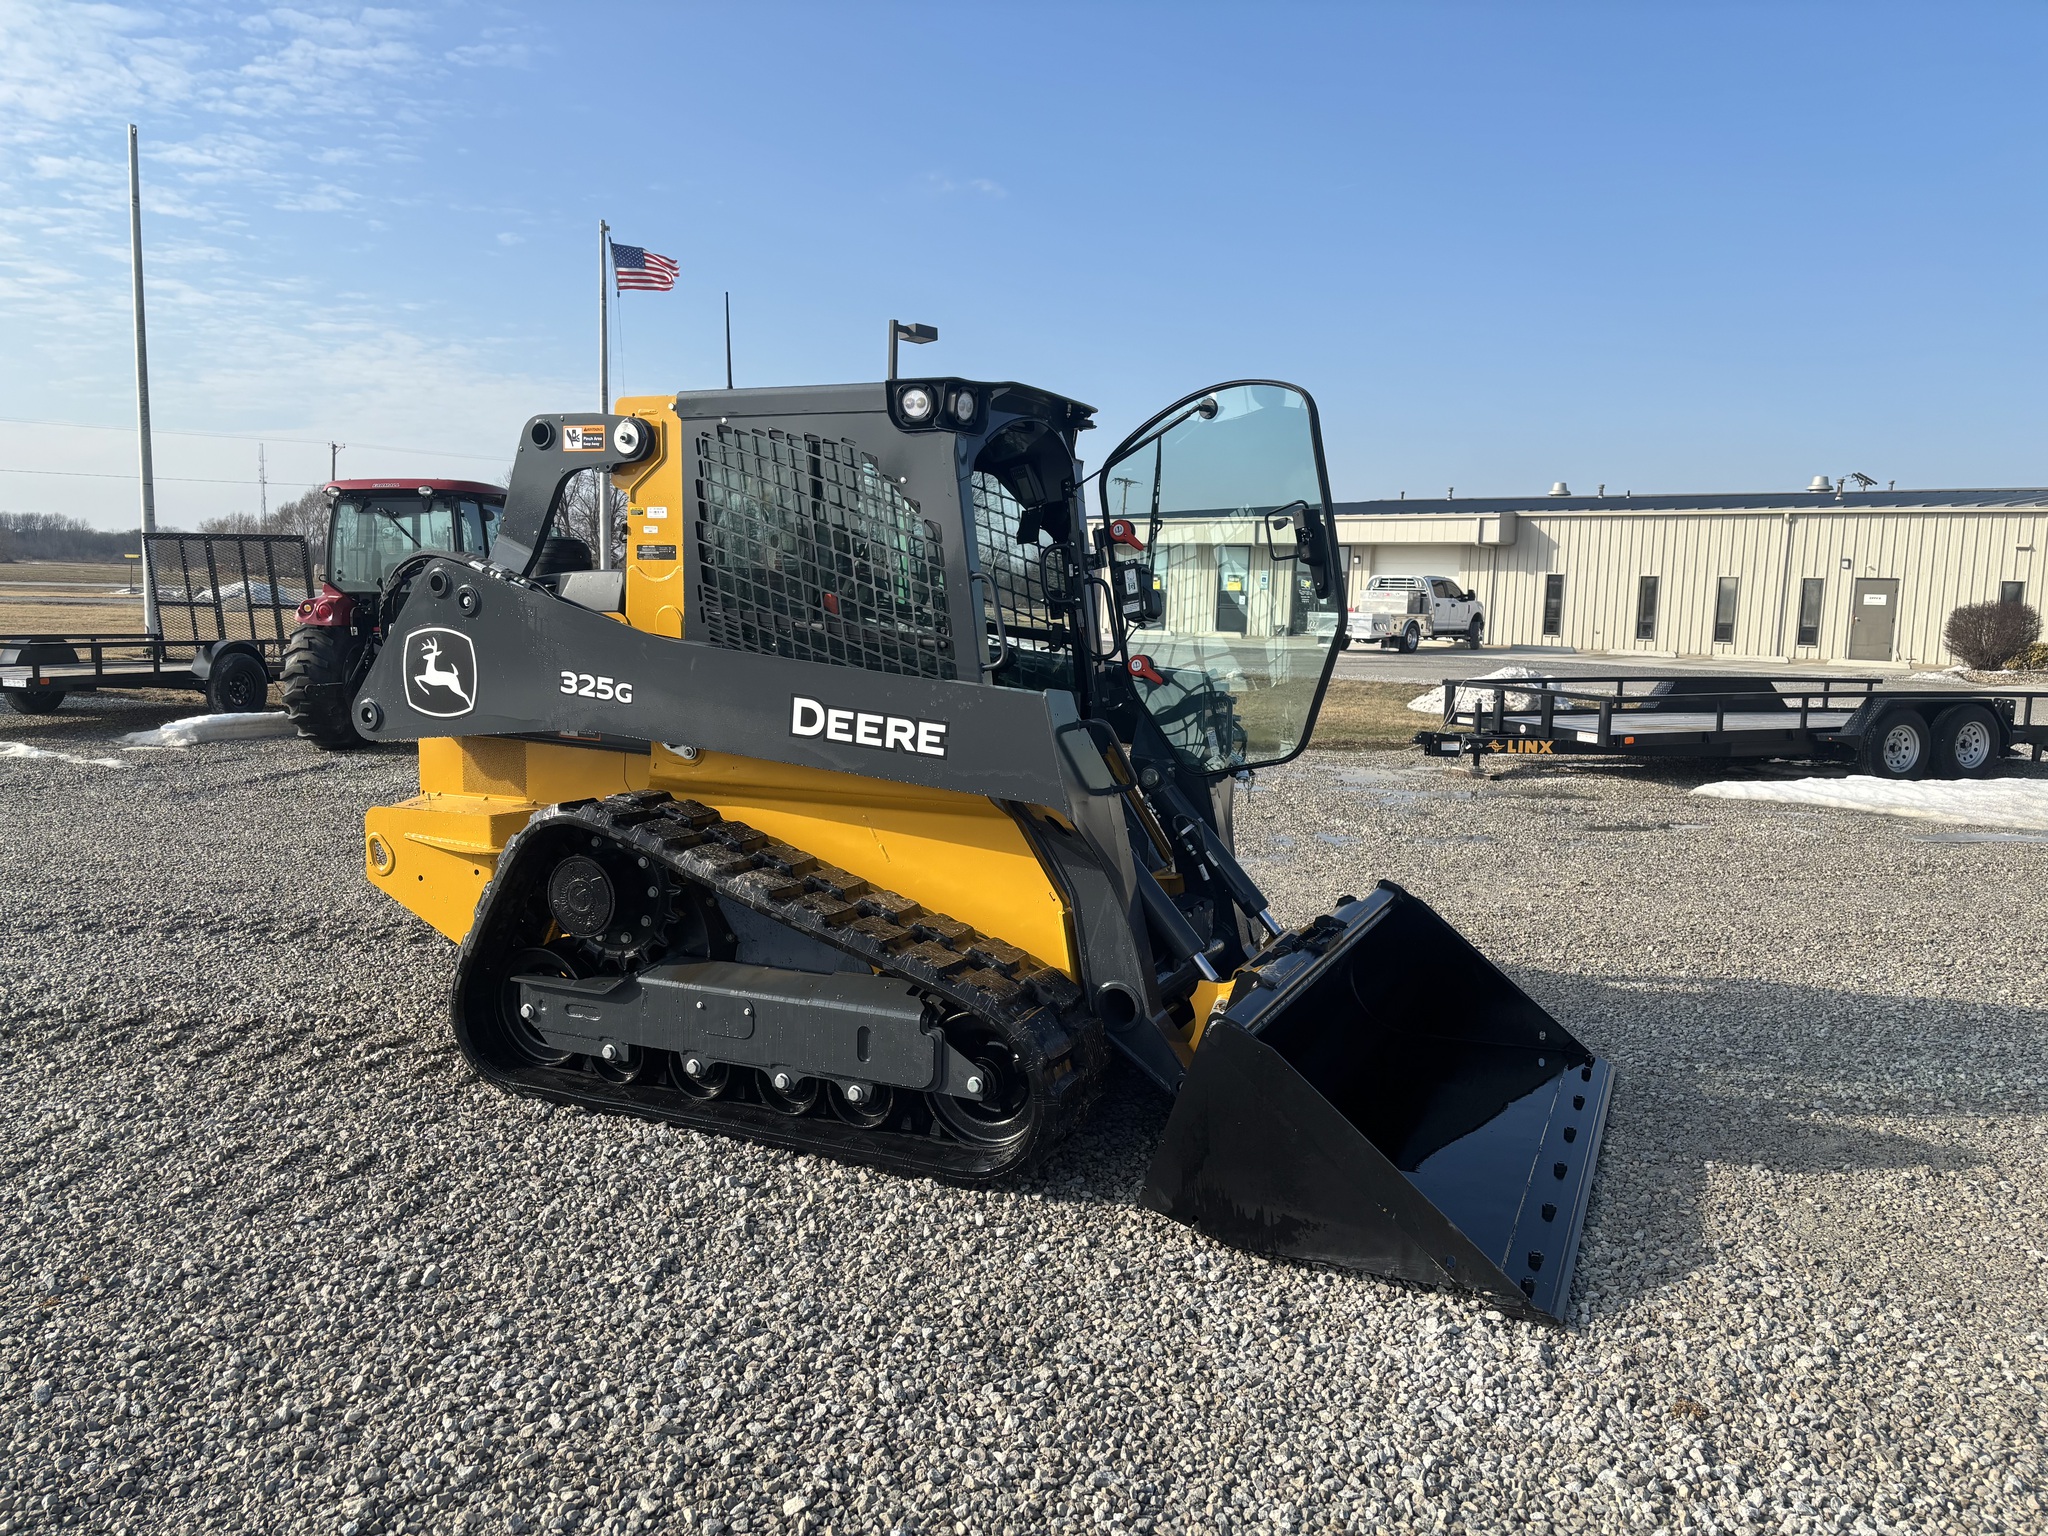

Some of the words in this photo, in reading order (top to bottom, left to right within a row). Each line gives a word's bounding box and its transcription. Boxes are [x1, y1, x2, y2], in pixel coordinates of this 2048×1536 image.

[560, 671, 633, 704] 325G
[792, 697, 947, 757] DEERE
[1507, 740, 1554, 754] LINX
